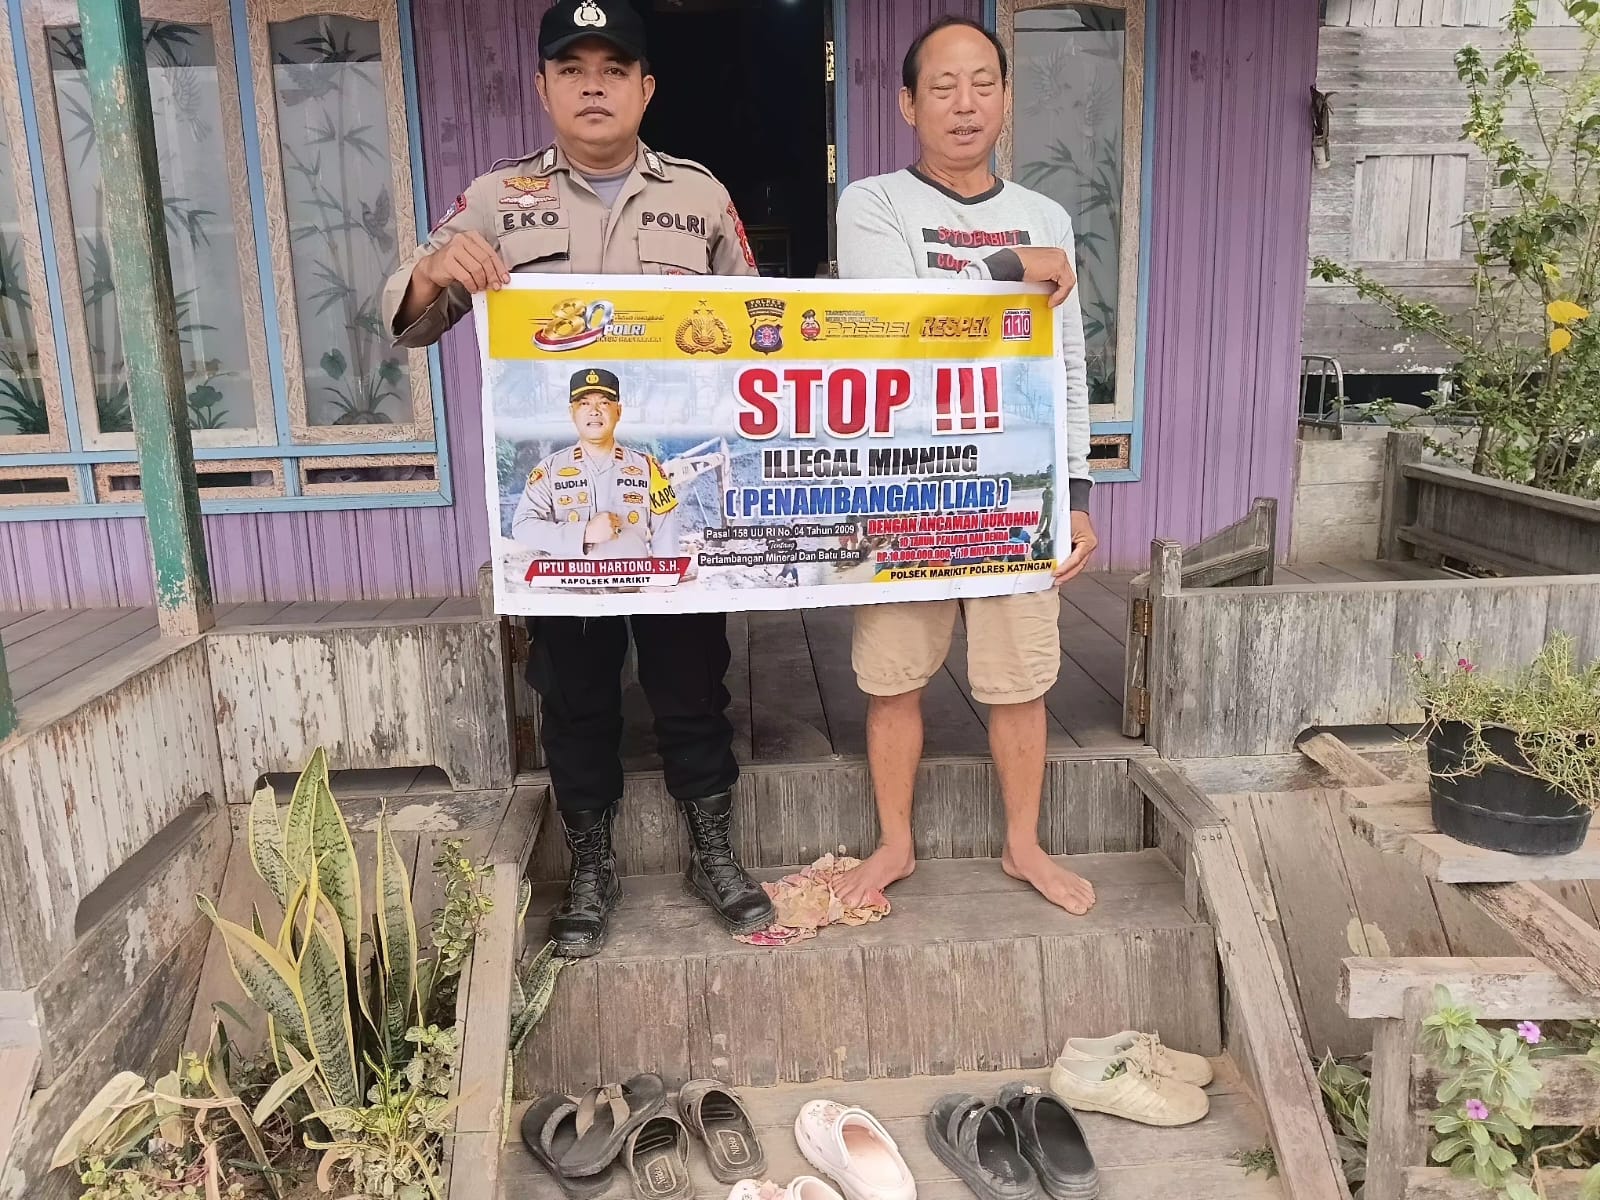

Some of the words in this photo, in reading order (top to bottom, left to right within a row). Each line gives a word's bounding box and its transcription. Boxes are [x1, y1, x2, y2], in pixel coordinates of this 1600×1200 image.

[503, 211, 559, 230] EKO
[641, 211, 706, 236] POLRI
[937, 226, 1020, 246] SPYDERBILT
[604, 323, 647, 337] POLRI
[920, 315, 990, 338] RESPEK
[1004, 316, 1031, 335] 110
[737, 367, 912, 436] STOP
[935, 366, 1000, 431] !!!
[764, 448, 861, 478] ILLEGAL
[868, 444, 978, 477] MINNING
[616, 478, 648, 489] POLRI
[743, 482, 937, 516] PENAMBANGAN
[942, 478, 995, 509] LIAR
[706, 529, 730, 539] Pasal
[751, 527, 764, 537] UU
[766, 527, 776, 537] RI
[794, 526, 805, 537] 04
[806, 525, 833, 536] Tahun
[835, 524, 855, 535] 2009
[868, 518, 918, 536] DENGAN
[919, 515, 979, 534] ANCAMAN
[981, 511, 1039, 529] HUKUMAN
[700, 553, 763, 566] Pertambangan
[766, 552, 797, 563] Mineral
[799, 551, 816, 561] Dan
[818, 550, 838, 560] Batu
[840, 549, 860, 559] Bara
[538, 560, 564, 574] IPTU
[568, 560, 595, 574] BUDI
[599, 560, 656, 575] HARTONO,
[658, 560, 680, 572] S.H.
[890, 569, 927, 580] POLSEK
[929, 567, 968, 578] MARIKIT
[969, 564, 1005, 575] POLRES
[1007, 561, 1052, 573] KATINGAN
[561, 576, 609, 585] KAPOLSEK
[612, 575, 651, 585] MARIKIT
